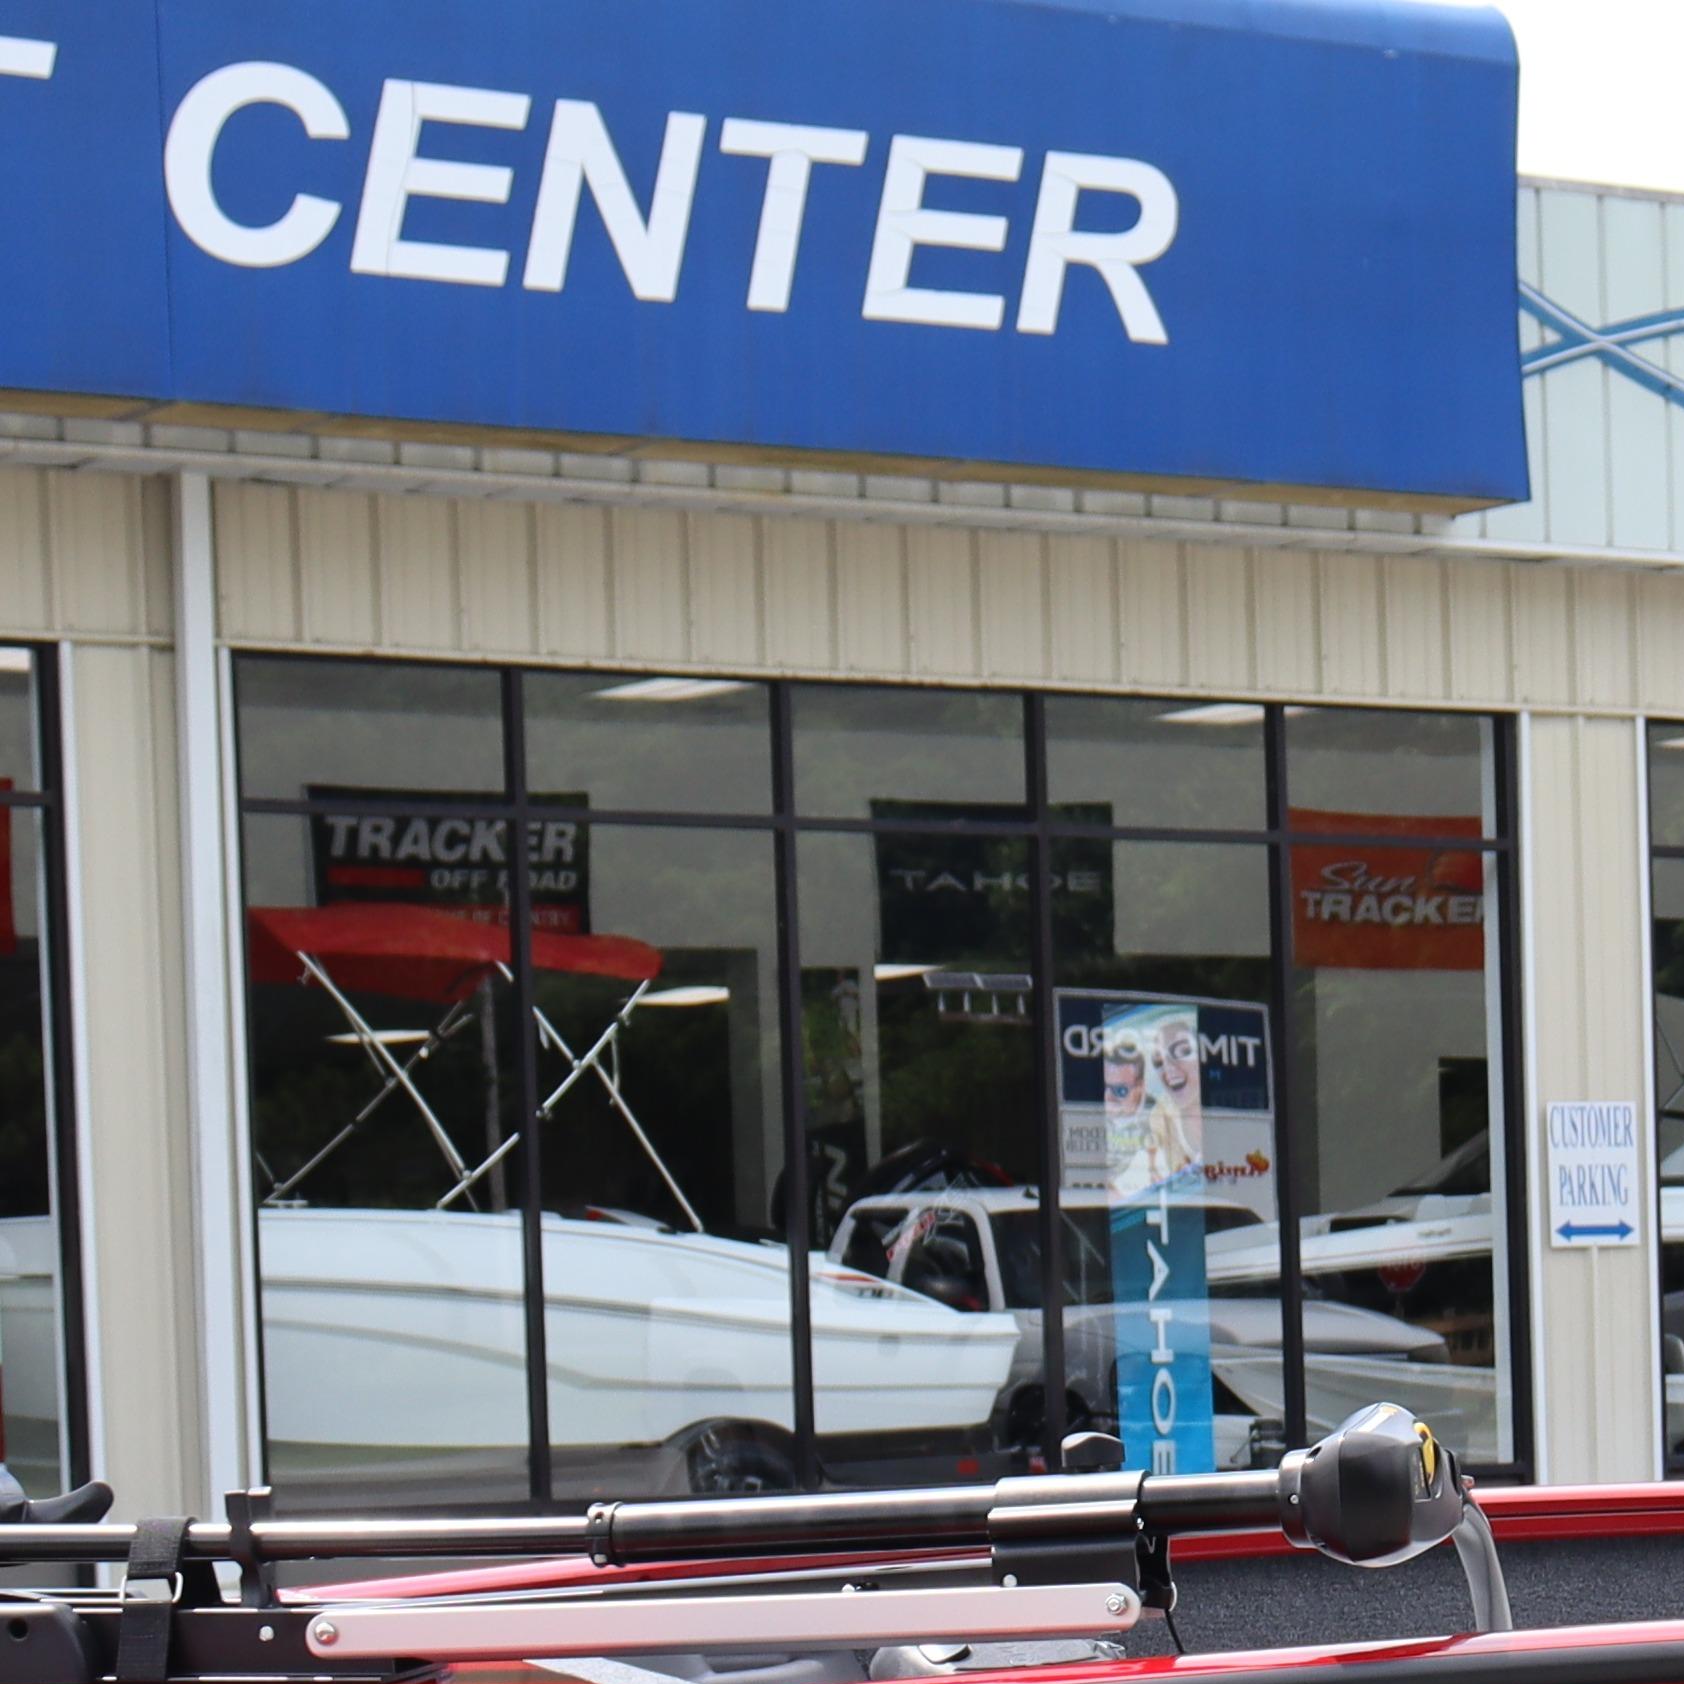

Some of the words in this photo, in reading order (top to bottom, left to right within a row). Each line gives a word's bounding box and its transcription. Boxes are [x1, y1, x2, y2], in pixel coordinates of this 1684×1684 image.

[165, 60, 1180, 346] CENTER
[430, 869, 489, 890] OFF
[890, 867, 1103, 891] TAHOE
[1320, 860, 1416, 894] Sun
[1550, 1105, 1634, 1149] CUSTOMER
[1559, 1163, 1629, 1207] PARKING
[1145, 1186, 1177, 1475] TAHOE
